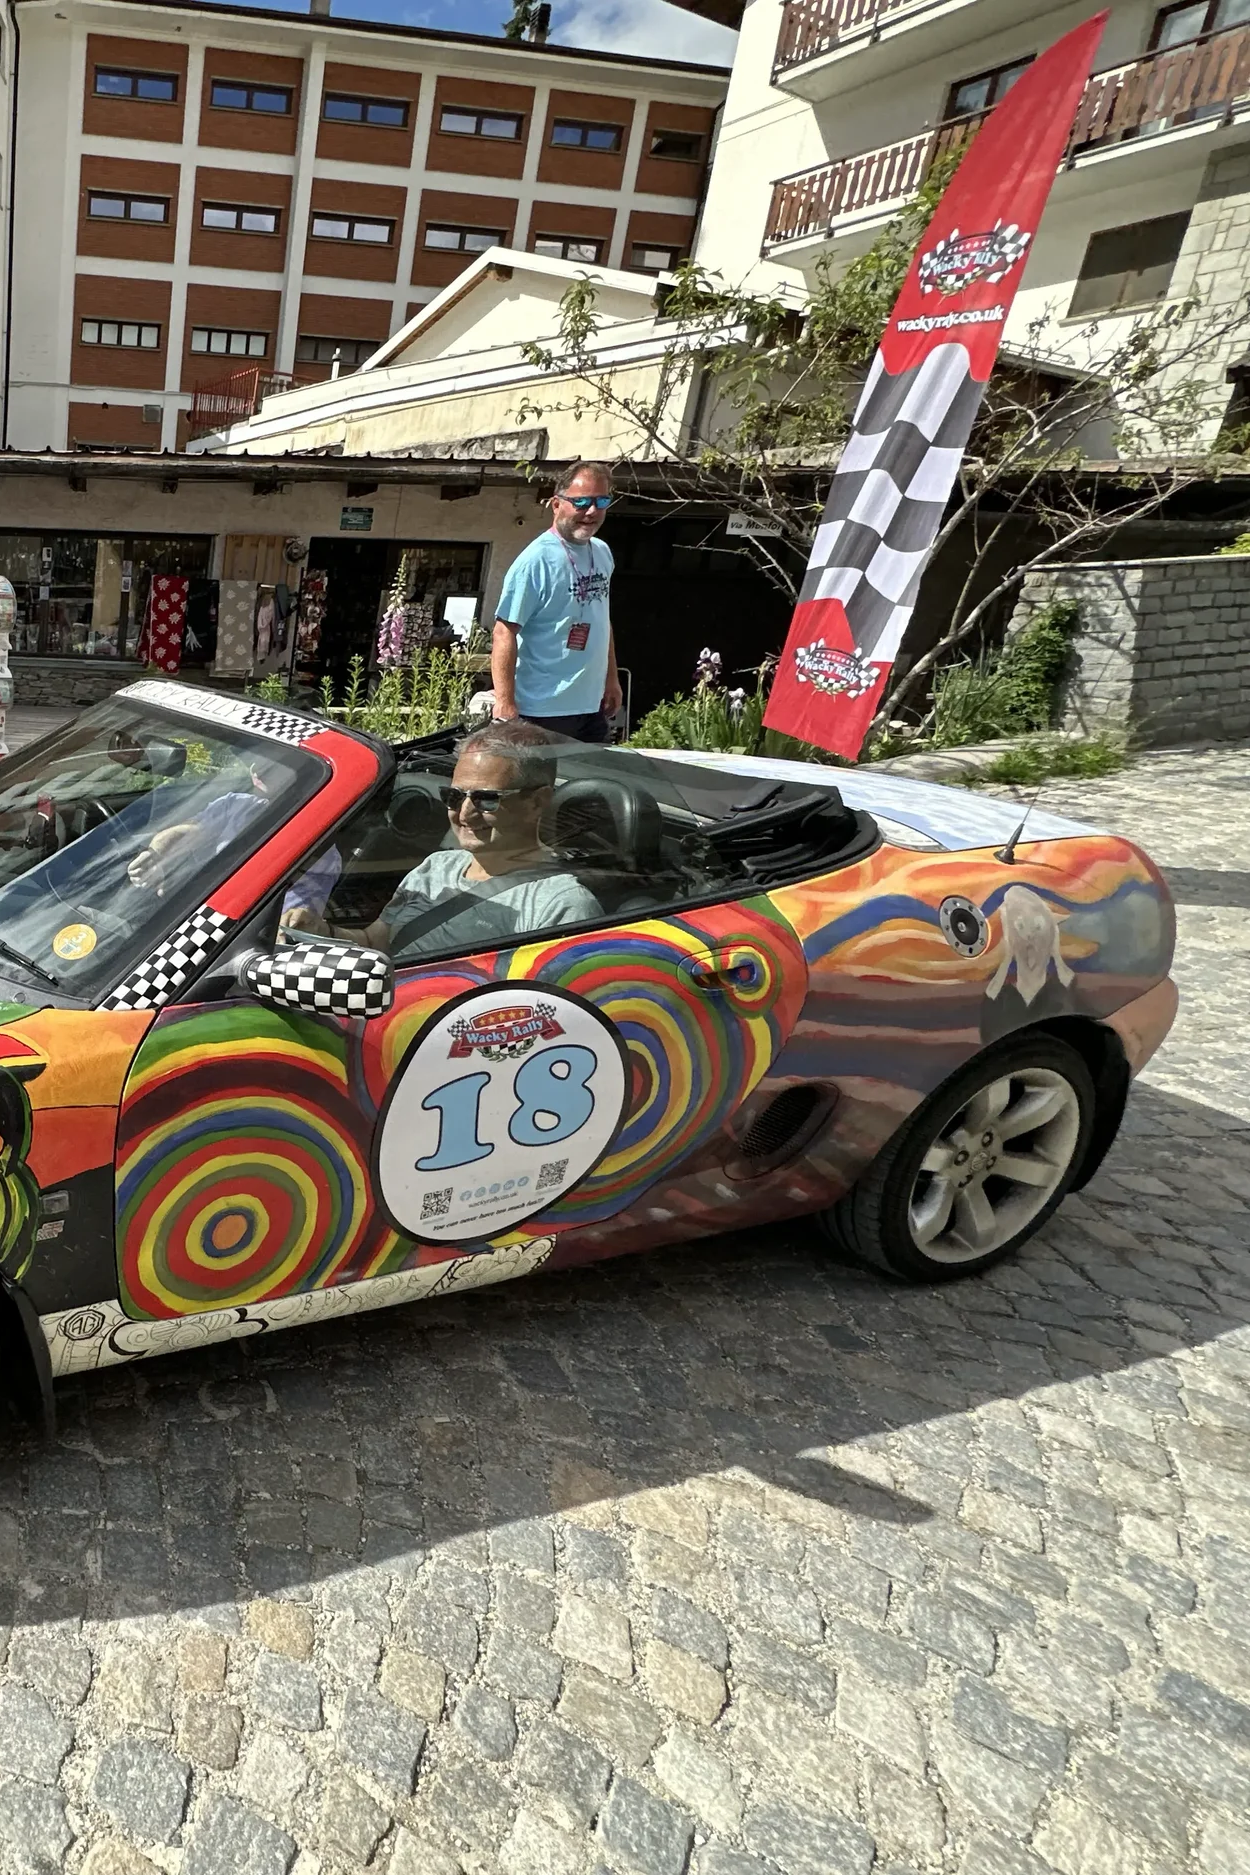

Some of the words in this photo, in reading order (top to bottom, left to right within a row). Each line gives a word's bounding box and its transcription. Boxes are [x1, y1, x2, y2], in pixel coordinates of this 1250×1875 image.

[730, 521, 743, 529] Via
[804, 659, 835, 675] Wacky
[835, 666, 859, 684] Rally
[177, 693, 249, 717] RALLY
[466, 1031, 508, 1044] Wacky
[512, 1020, 543, 1037] Rally
[415, 1044, 598, 1171] 18
[446, 1220, 458, 1228] can
[459, 1216, 478, 1224] never
[507, 1202, 525, 1211] much
